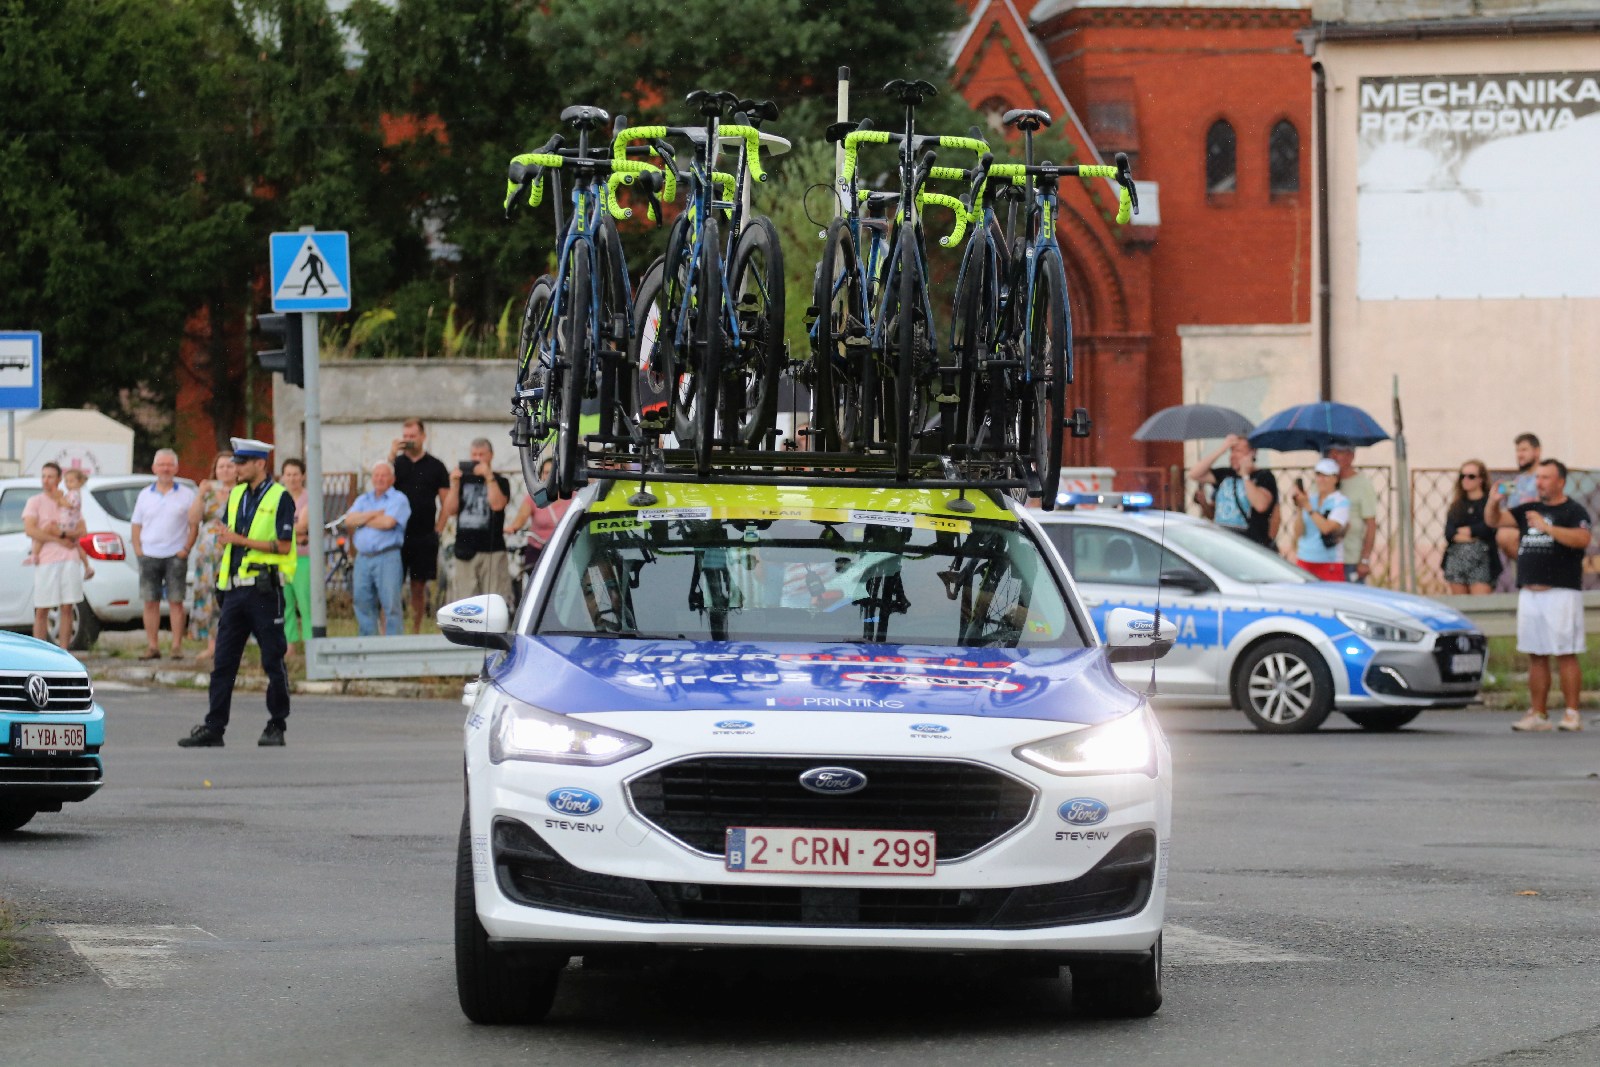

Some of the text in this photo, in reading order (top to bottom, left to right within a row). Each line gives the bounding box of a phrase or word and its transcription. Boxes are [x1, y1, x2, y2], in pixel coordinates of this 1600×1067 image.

[1361, 79, 1600, 107] MECHANIKA
[1360, 107, 1577, 133] POJAZDOWA
[577, 193, 586, 232] CUBE
[1043, 200, 1051, 239] CUBE
[760, 509, 803, 517] TEAM
[626, 671, 812, 687] Circus
[803, 697, 905, 709] PRINTING
[23, 728, 83, 746] 1-YBA-505
[814, 771, 852, 790] Ford
[554, 790, 594, 812] Ford
[1065, 800, 1102, 822] Ford
[545, 819, 604, 833] STEVENY
[1055, 831, 1110, 841] STEVENY
[730, 835, 930, 868] B 2-CRN-299
